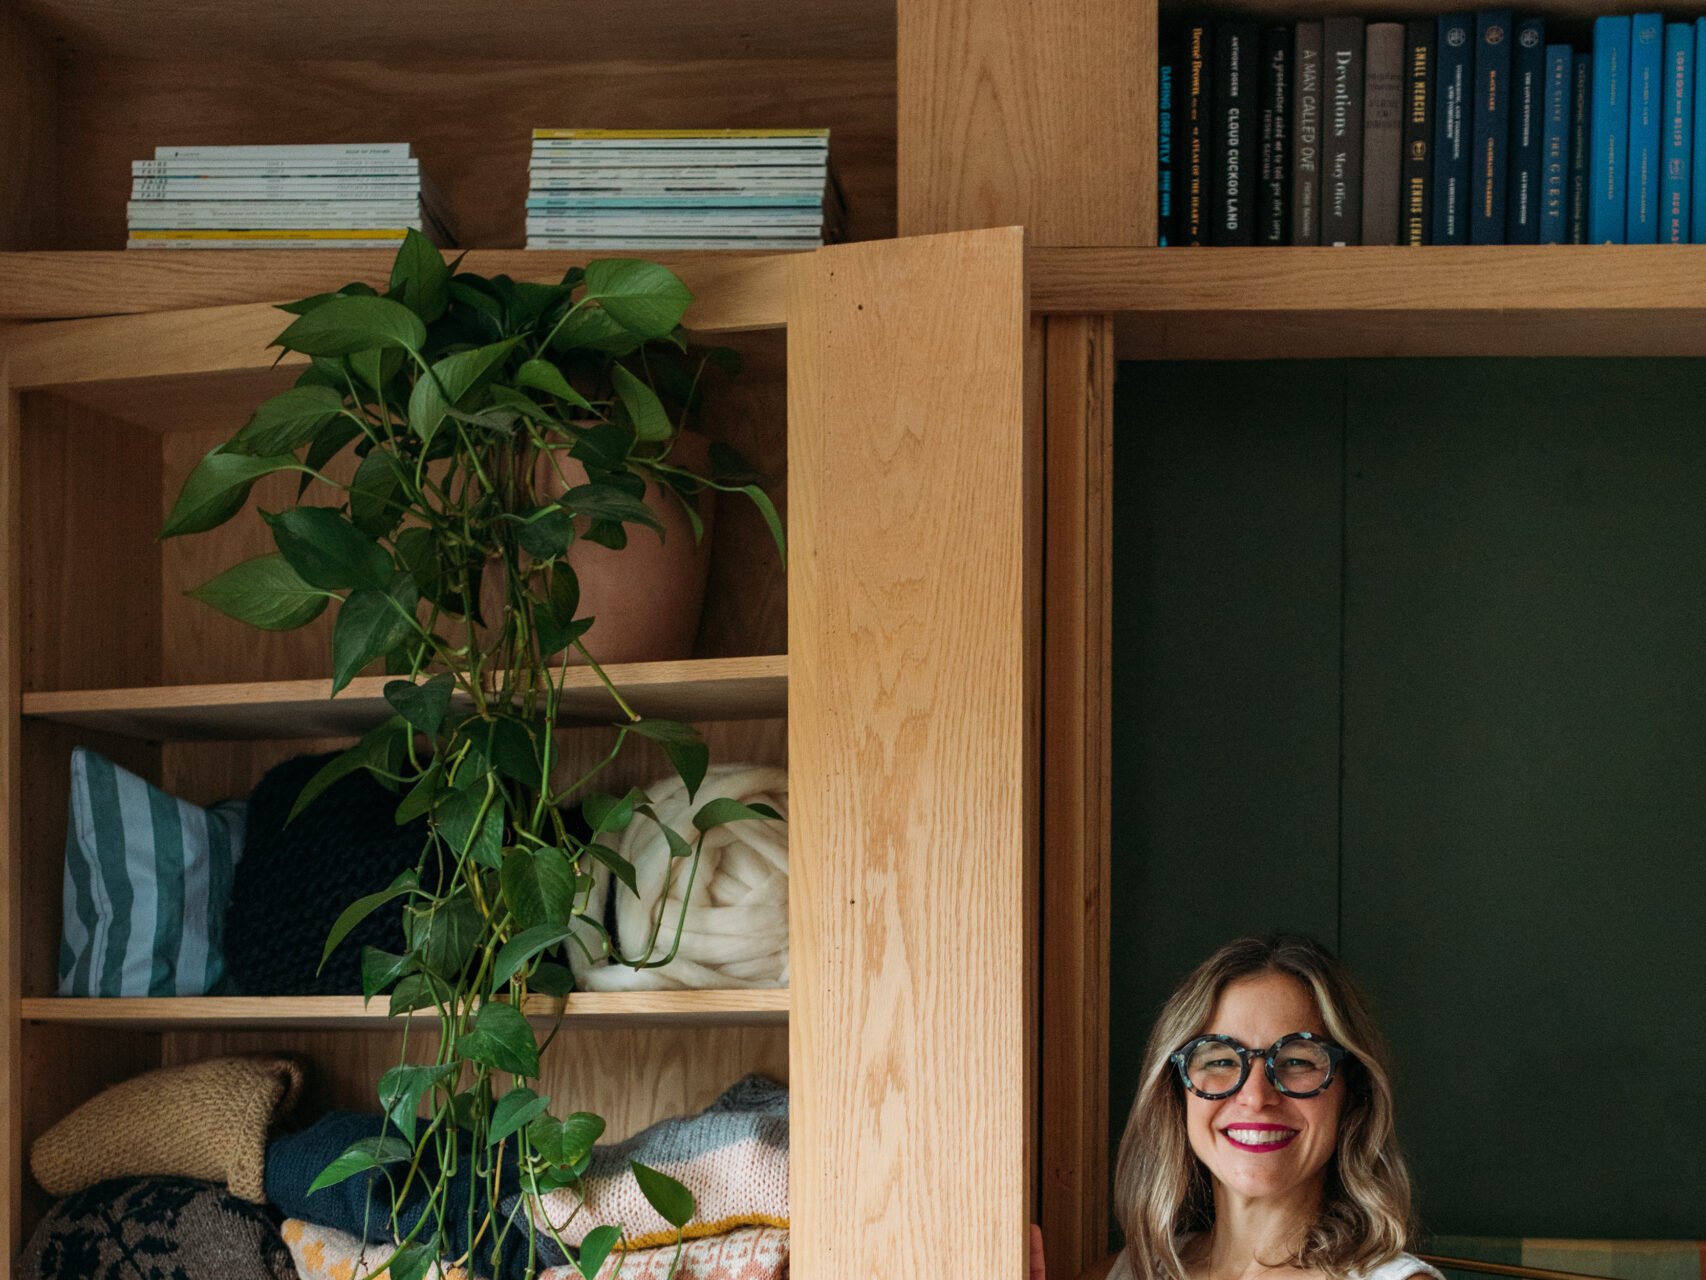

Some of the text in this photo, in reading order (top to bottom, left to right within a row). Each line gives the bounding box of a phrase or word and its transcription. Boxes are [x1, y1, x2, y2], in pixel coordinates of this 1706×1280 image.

[1192, 28, 1202, 58] Brené
[1231, 36, 1239, 70] ANTHONY
[1675, 51, 1684, 98] SORROW
[1159, 66, 1172, 164] DARING GREATLY
[1300, 50, 1317, 172] A MAN CALLED OVE
[1334, 50, 1352, 136] Devotions
[1412, 46, 1427, 123] SMALL MERCIES
[1674, 118, 1682, 147] BLISS
[1191, 138, 1200, 224] ATLAS OF THE HEART
[1226, 108, 1240, 230] CLOUD CUCKOO LAND
[1270, 182, 1282, 196] you
[1332, 152, 1346, 217] Mary Oliver
[1410, 177, 1424, 213] DENNIS
[1548, 136, 1560, 218] THE GUEST
